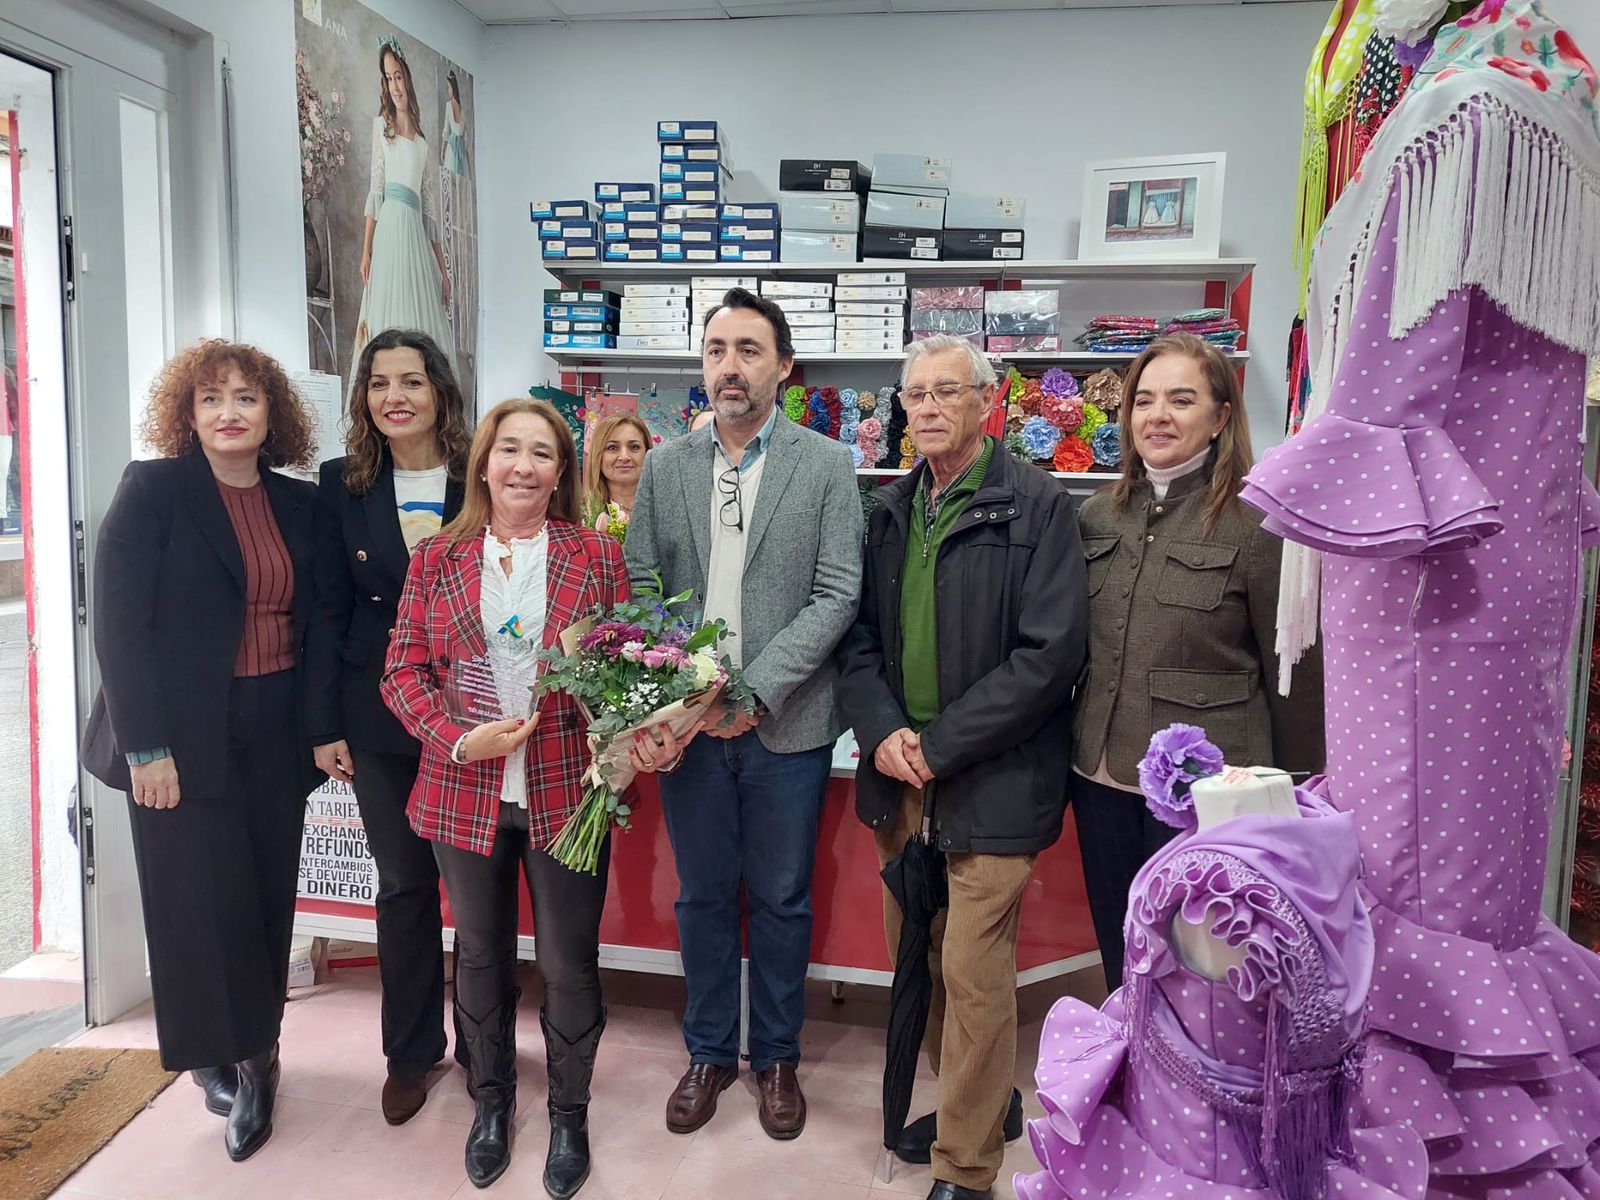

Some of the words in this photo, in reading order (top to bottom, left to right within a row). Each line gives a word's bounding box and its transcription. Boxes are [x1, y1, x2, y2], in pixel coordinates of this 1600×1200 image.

[317, 800, 359, 820] TARJE
[306, 836, 373, 860] REFUNDS
[301, 857, 373, 873] NTERCAMBIOS
[299, 867, 313, 879] SE
[317, 868, 372, 885] DEVUELVE
[307, 880, 372, 900] DINERO
